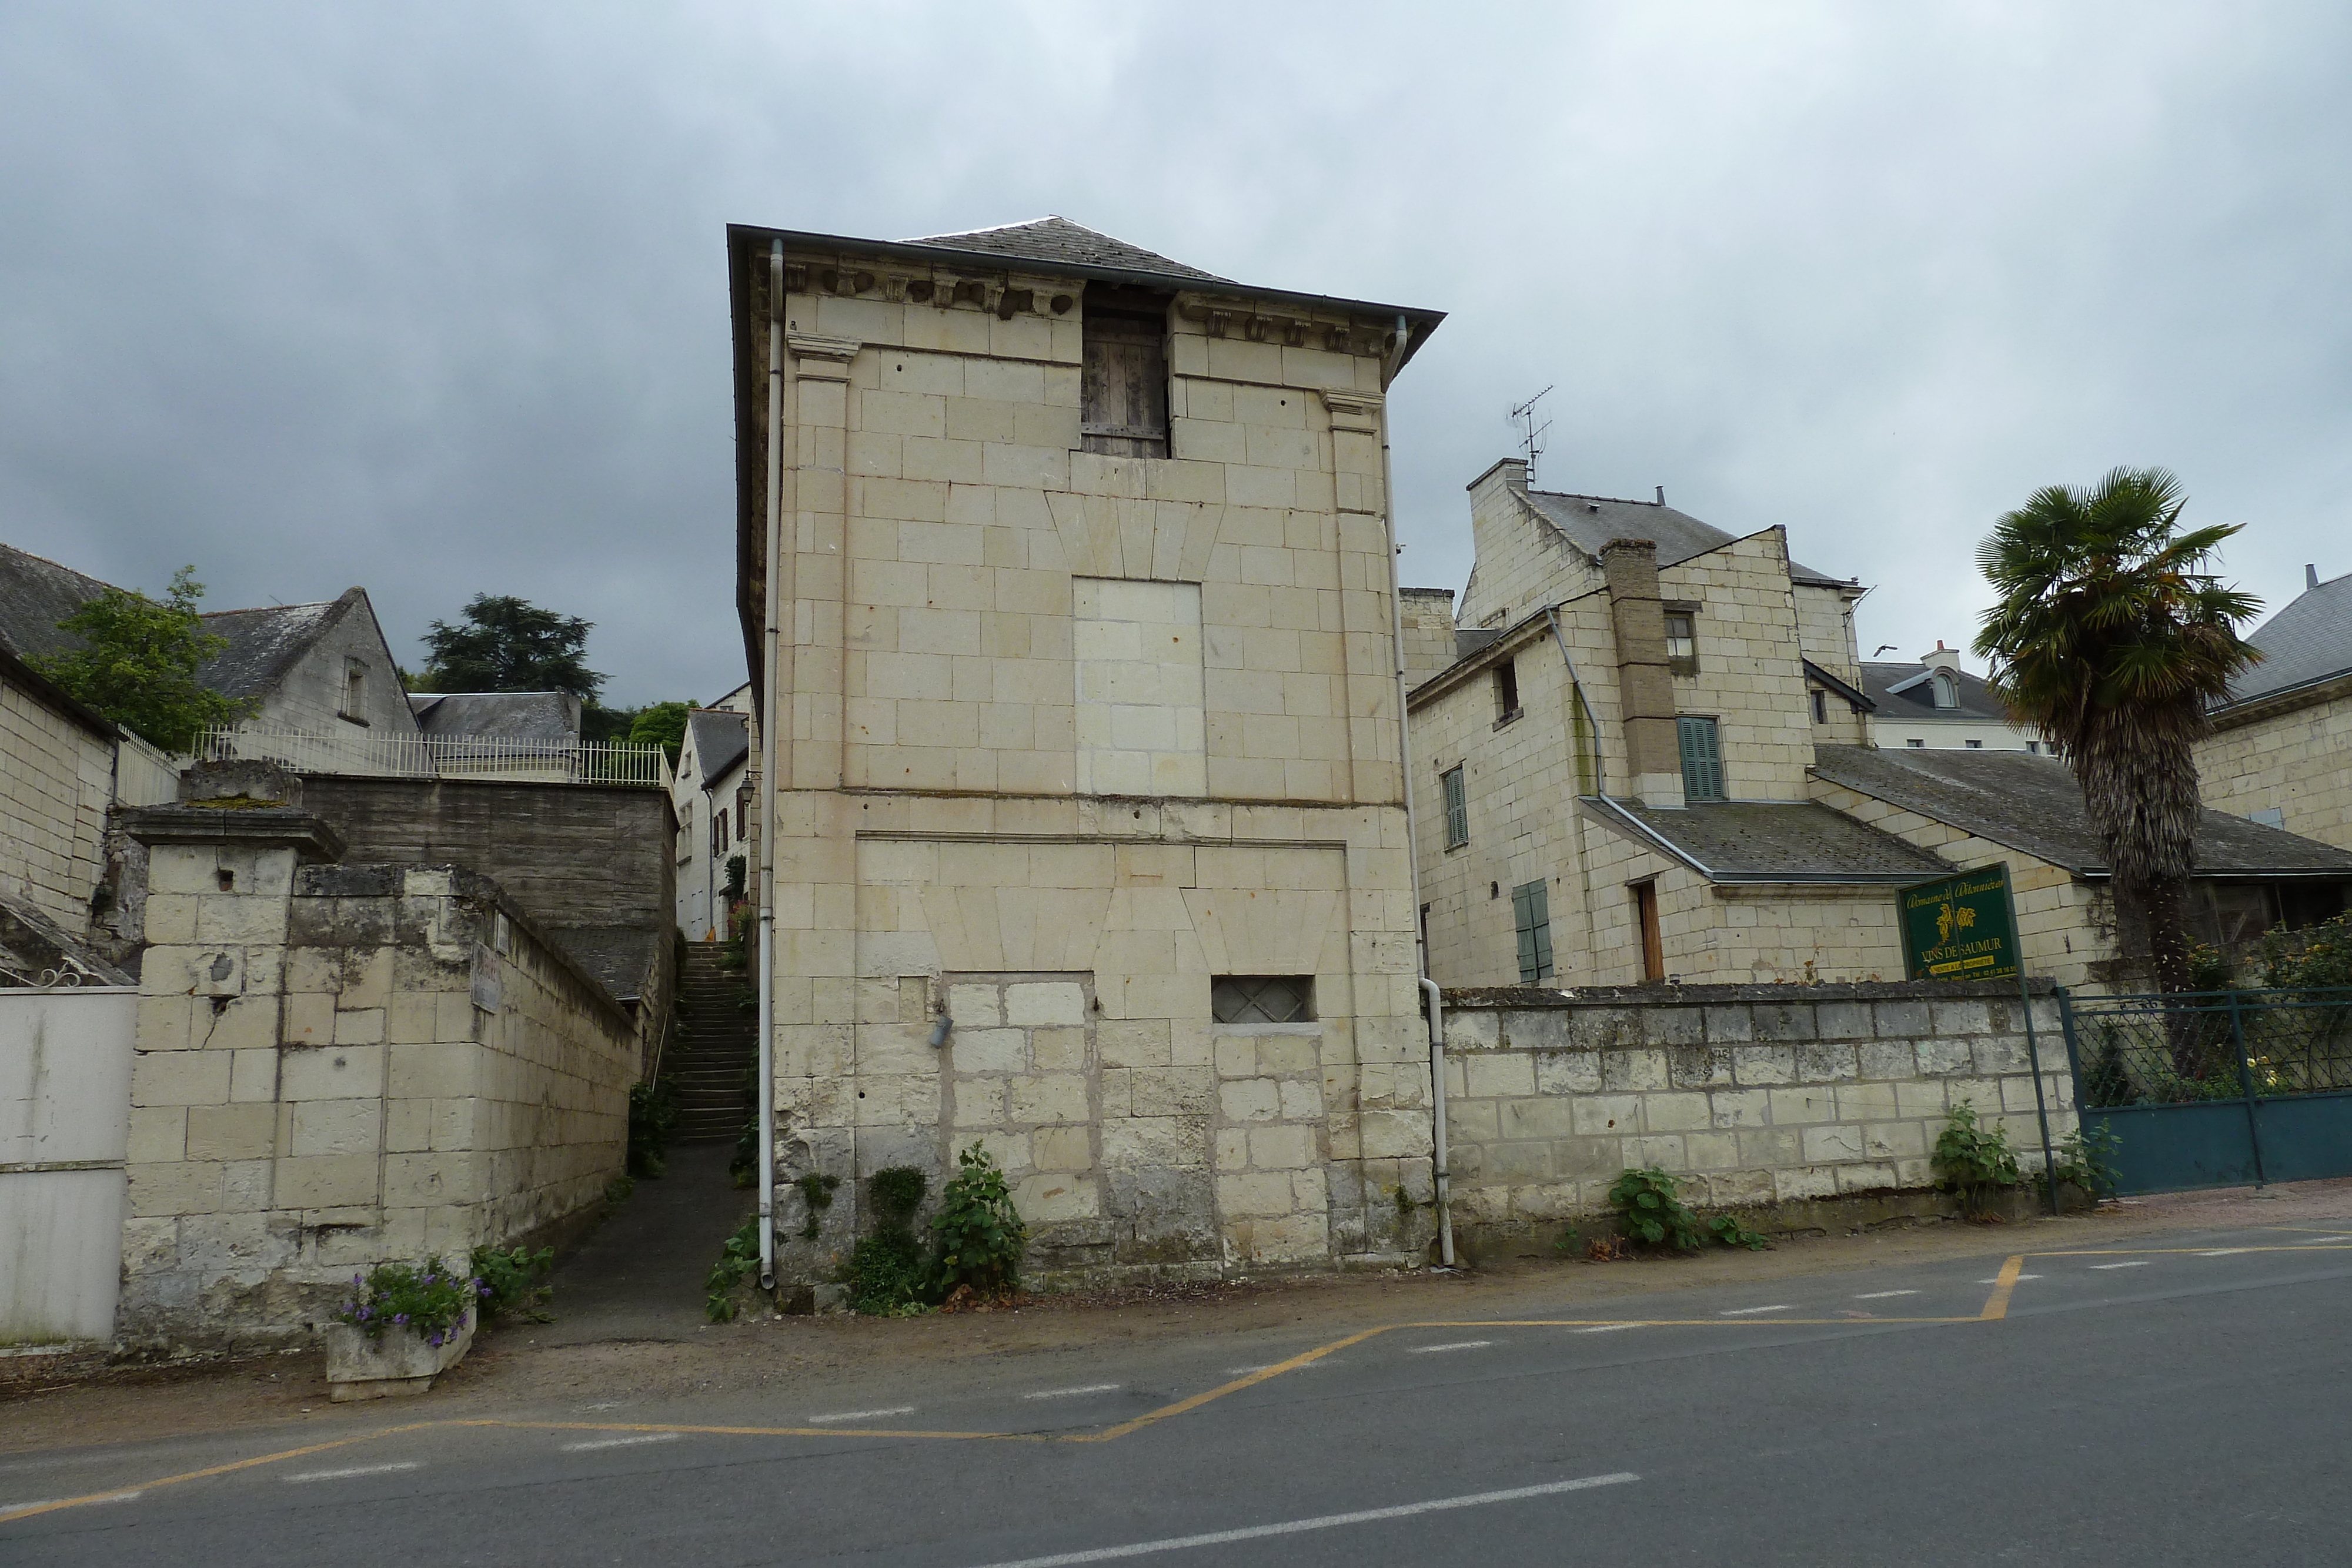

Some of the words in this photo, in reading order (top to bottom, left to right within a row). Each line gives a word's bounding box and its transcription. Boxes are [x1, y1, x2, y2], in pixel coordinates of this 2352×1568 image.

[1907, 893, 1942, 908] Domaine
[1921, 949, 1943, 961] VINS
[1945, 947, 1958, 958] DE
[1960, 937, 2002, 955] SAUMUR
